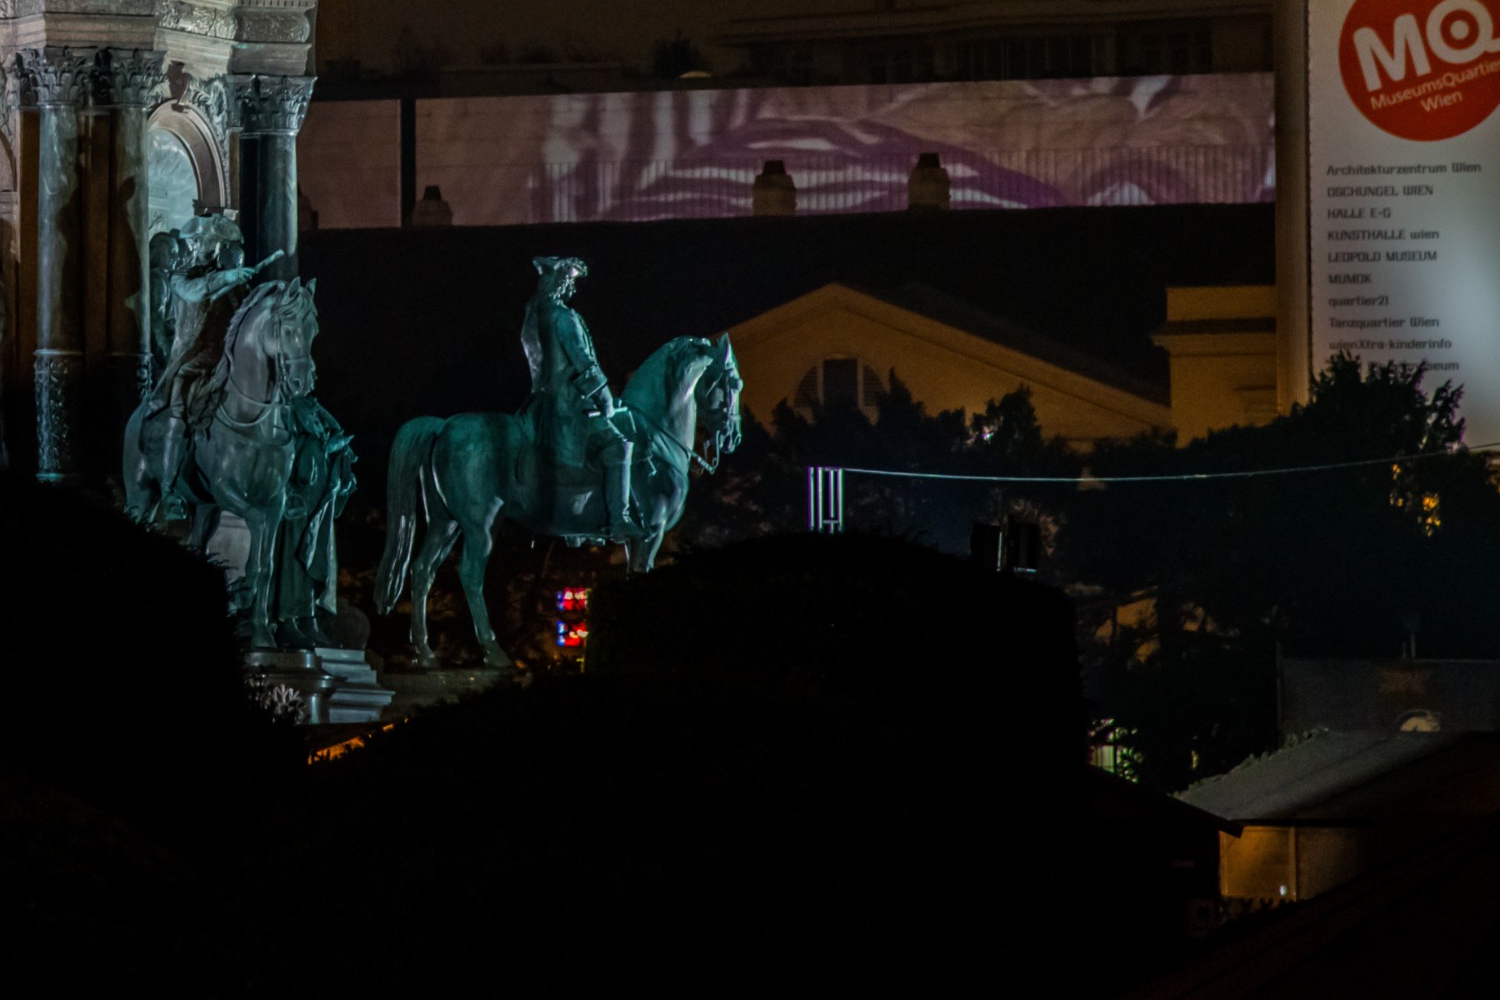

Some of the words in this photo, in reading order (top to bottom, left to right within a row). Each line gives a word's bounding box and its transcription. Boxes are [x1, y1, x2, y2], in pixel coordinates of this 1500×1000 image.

[1370, 60, 1500, 111] MuseumsQuartie
[1420, 91, 1463, 112] Wien
[1326, 163, 1447, 176] Architekturzentrum
[1452, 162, 1482, 173] Wien
[1327, 186, 1399, 197] DSCHUNGEL
[1403, 185, 1434, 196] WIEN
[1327, 208, 1365, 219] HALLE
[1327, 229, 1406, 241] KUNSTHALLE
[1410, 230, 1440, 239] wien
[1328, 252, 1381, 263] LEOPOLD
[1386, 251, 1438, 262] MUSEUM
[1328, 274, 1372, 285] MUMOK
[1328, 296, 1389, 308] quartier21
[1329, 317, 1405, 329] Tanzquartier
[1410, 317, 1440, 328] Wien
